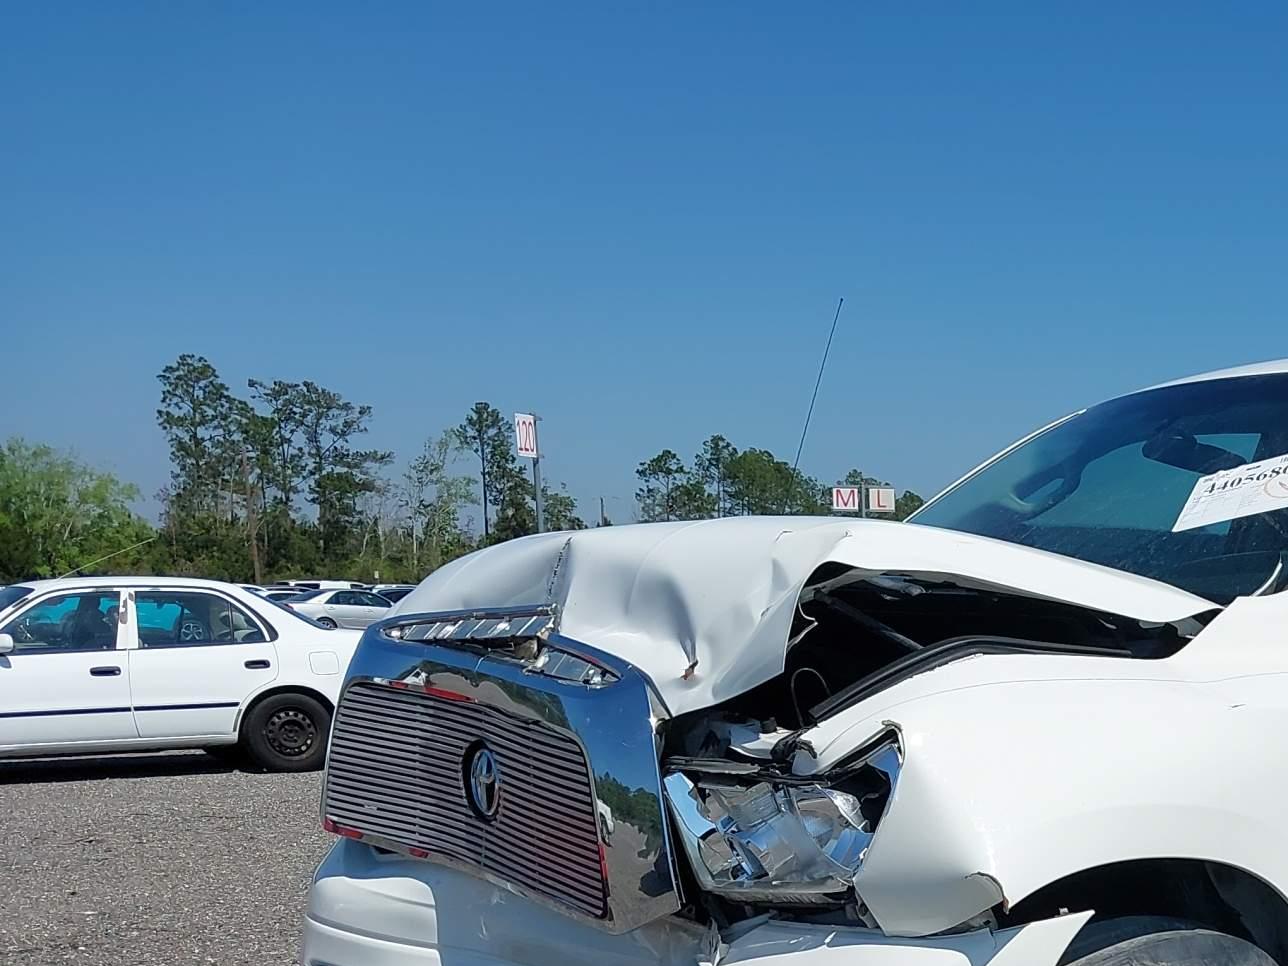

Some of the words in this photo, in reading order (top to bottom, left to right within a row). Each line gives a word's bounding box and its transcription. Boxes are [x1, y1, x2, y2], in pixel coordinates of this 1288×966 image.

[516, 420, 535, 453] 120
[835, 488, 856, 508] M
[876, 489, 888, 508] L
